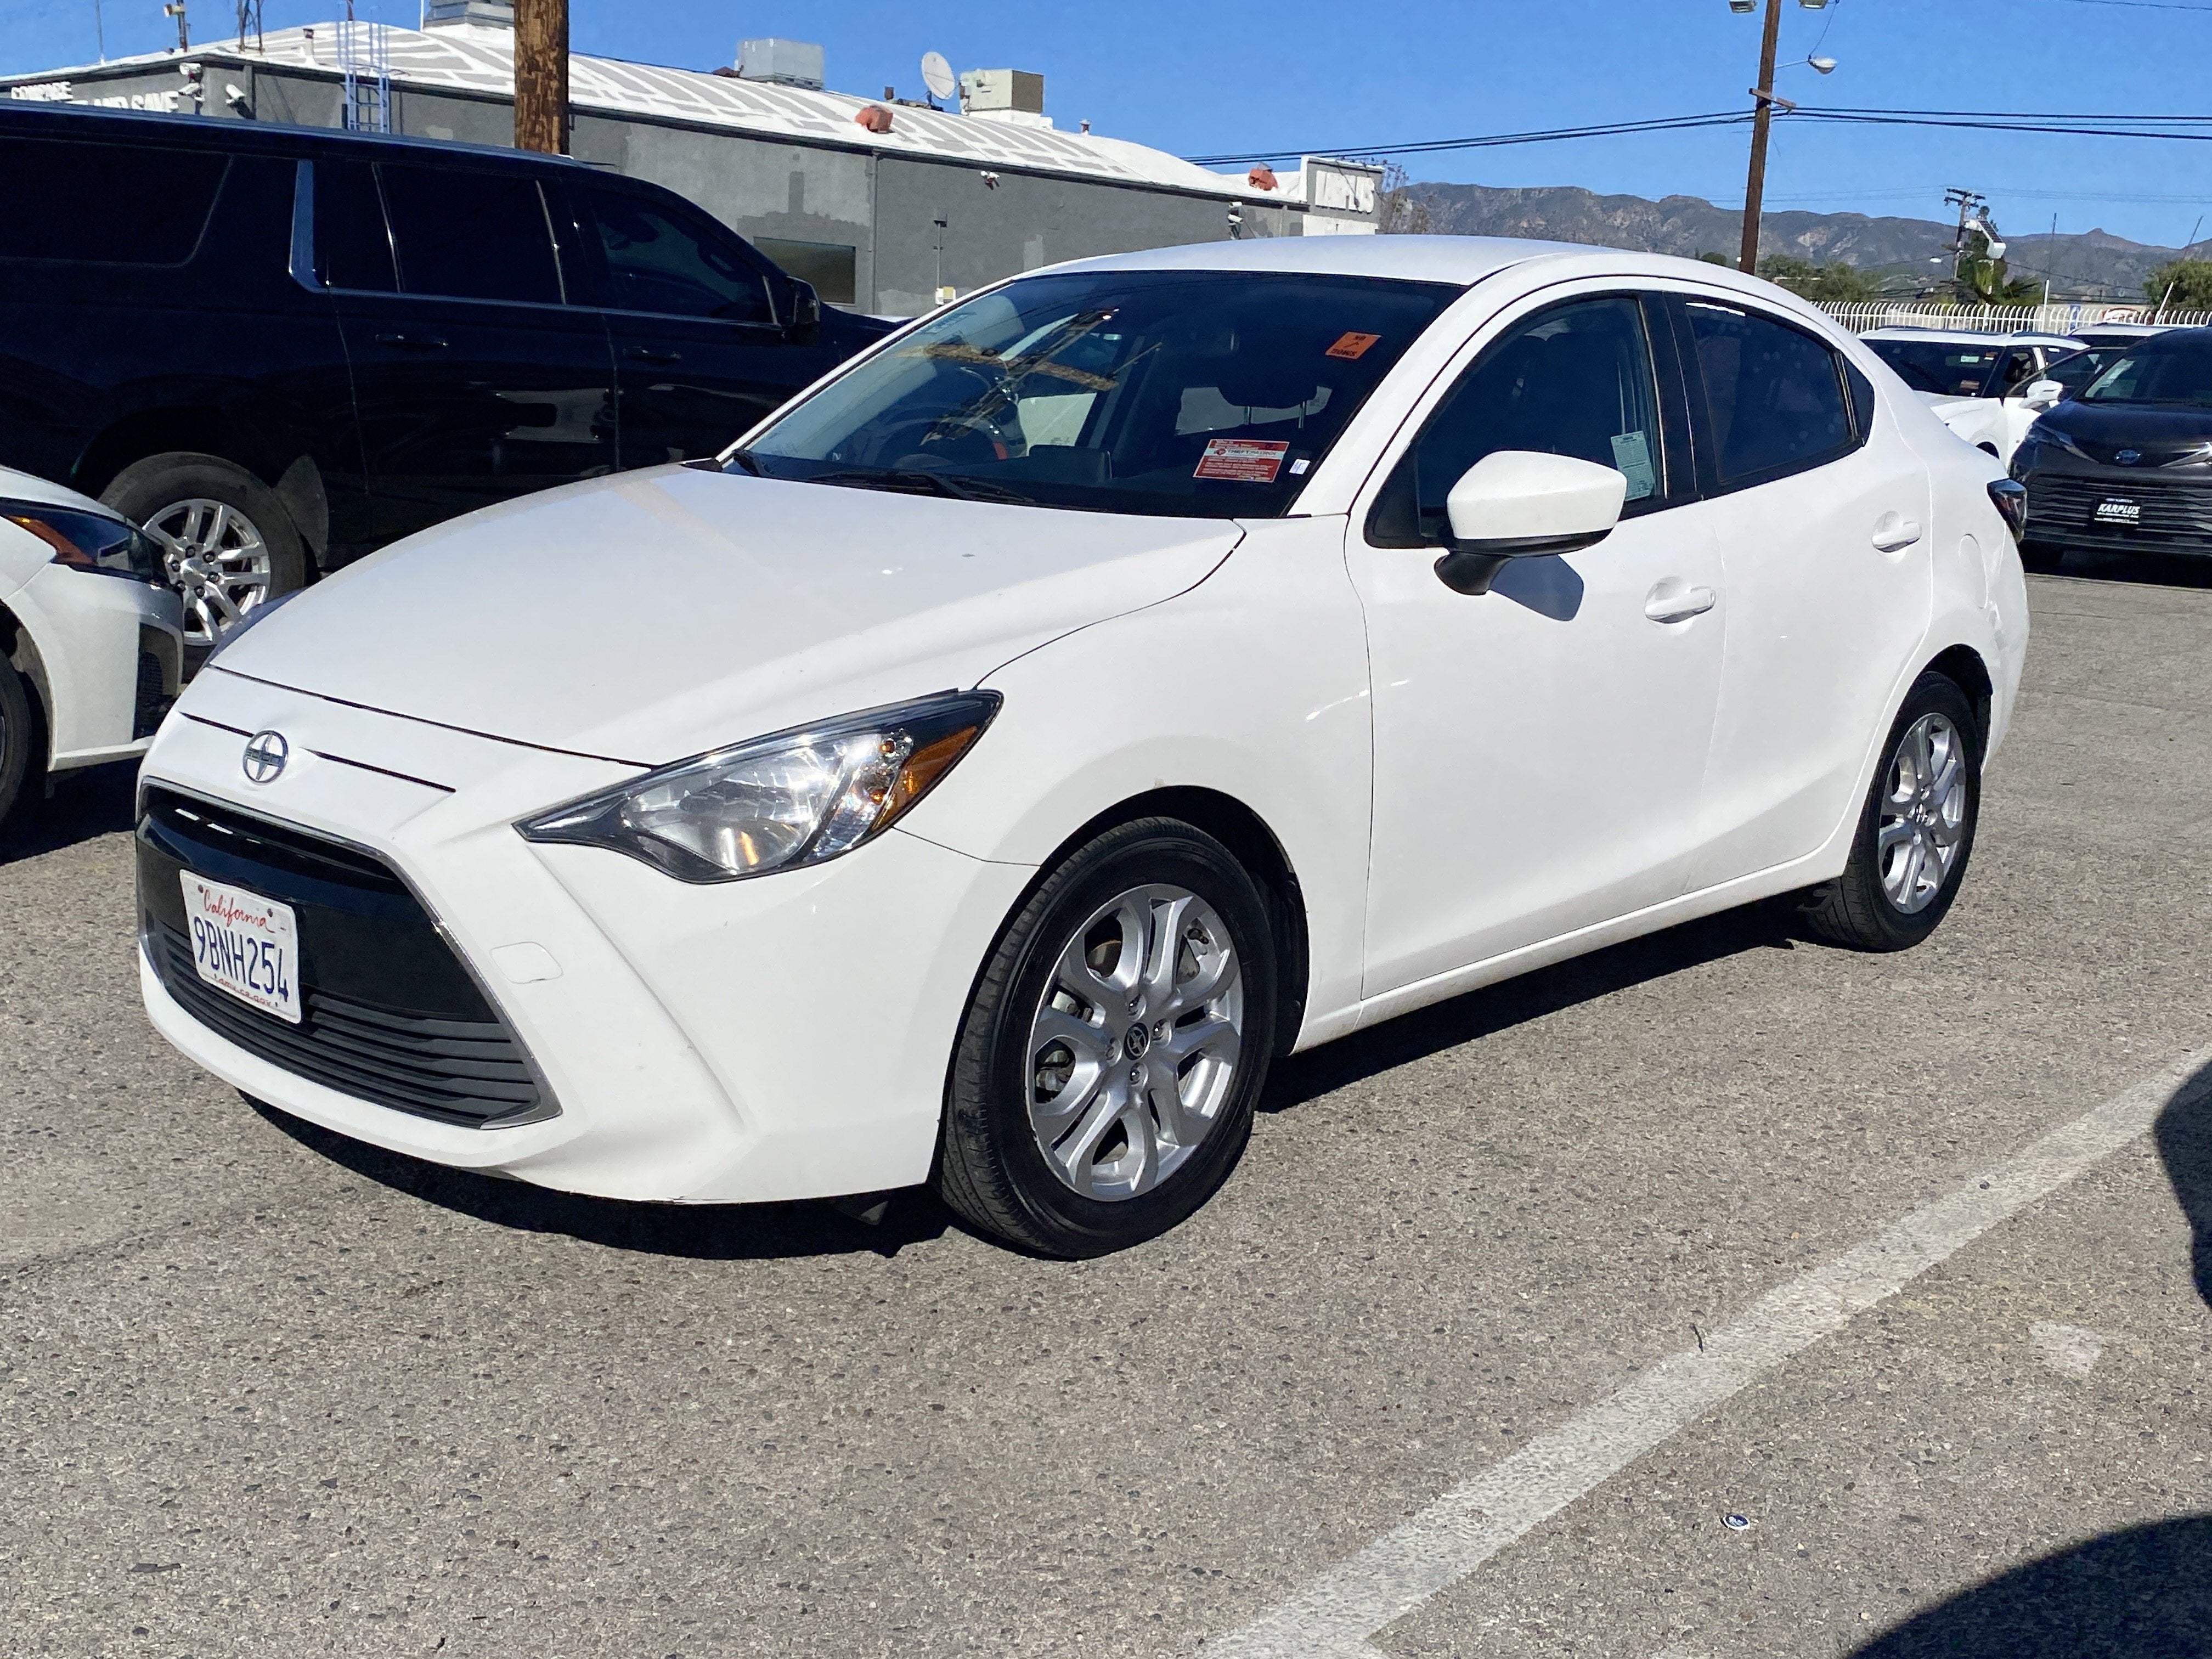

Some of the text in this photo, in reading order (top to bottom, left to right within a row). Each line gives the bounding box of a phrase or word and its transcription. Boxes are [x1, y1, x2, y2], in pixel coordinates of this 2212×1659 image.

[2097, 503, 2141, 515] KARPLUS
[204, 888, 276, 934] California
[194, 916, 289, 1003] 9BNH254
